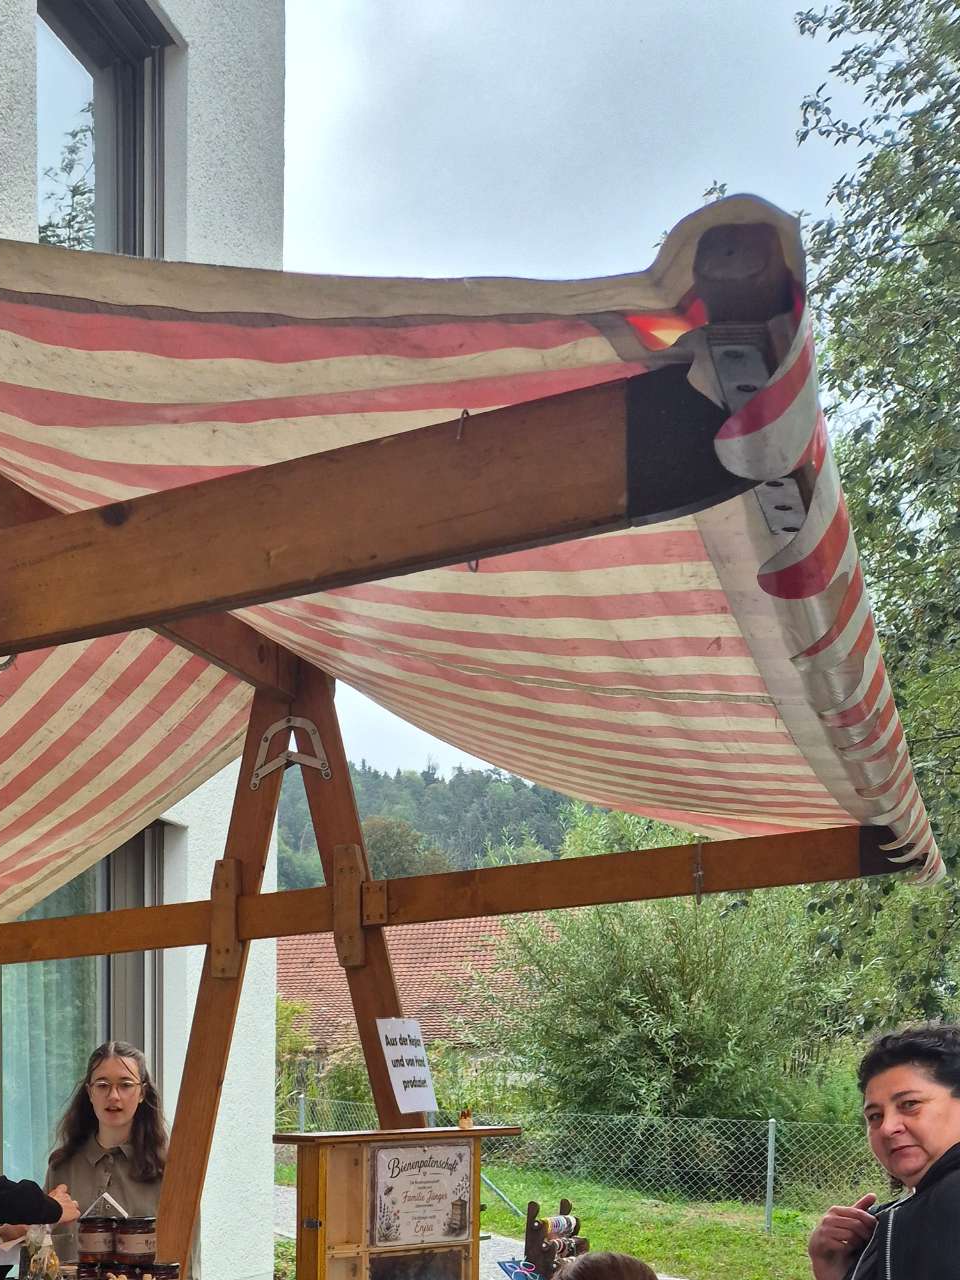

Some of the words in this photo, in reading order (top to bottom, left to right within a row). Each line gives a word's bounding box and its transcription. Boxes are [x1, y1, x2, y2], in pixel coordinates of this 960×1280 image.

[384, 1034, 398, 1047] Aus
[399, 1033, 408, 1046] der
[391, 1055, 405, 1068] und
[387, 1155, 459, 1178] Bienenpatenschaft
